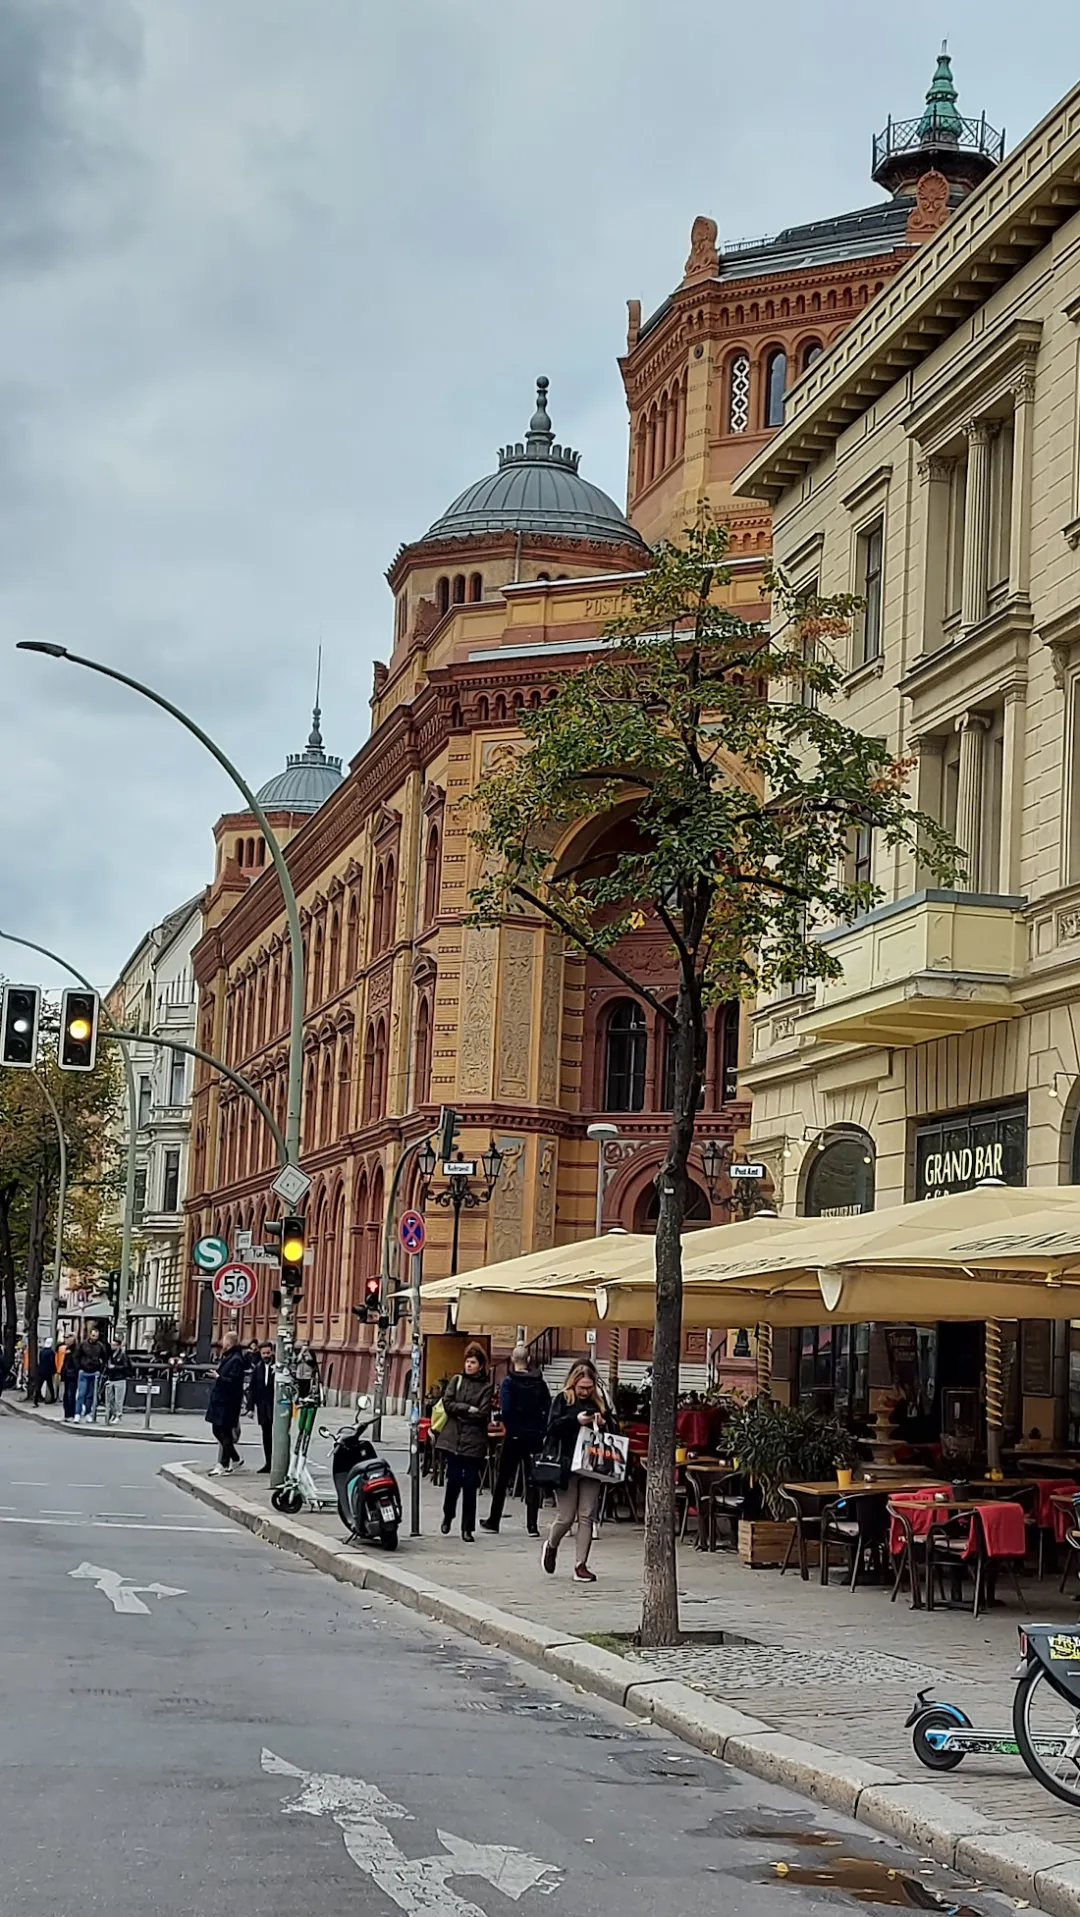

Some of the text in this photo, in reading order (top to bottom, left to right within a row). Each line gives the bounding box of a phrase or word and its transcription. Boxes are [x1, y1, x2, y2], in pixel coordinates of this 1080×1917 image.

[925, 1143, 1003, 1187] GRAND BAR
[199, 1238, 223, 1268] S
[223, 1275, 248, 1295] 50
